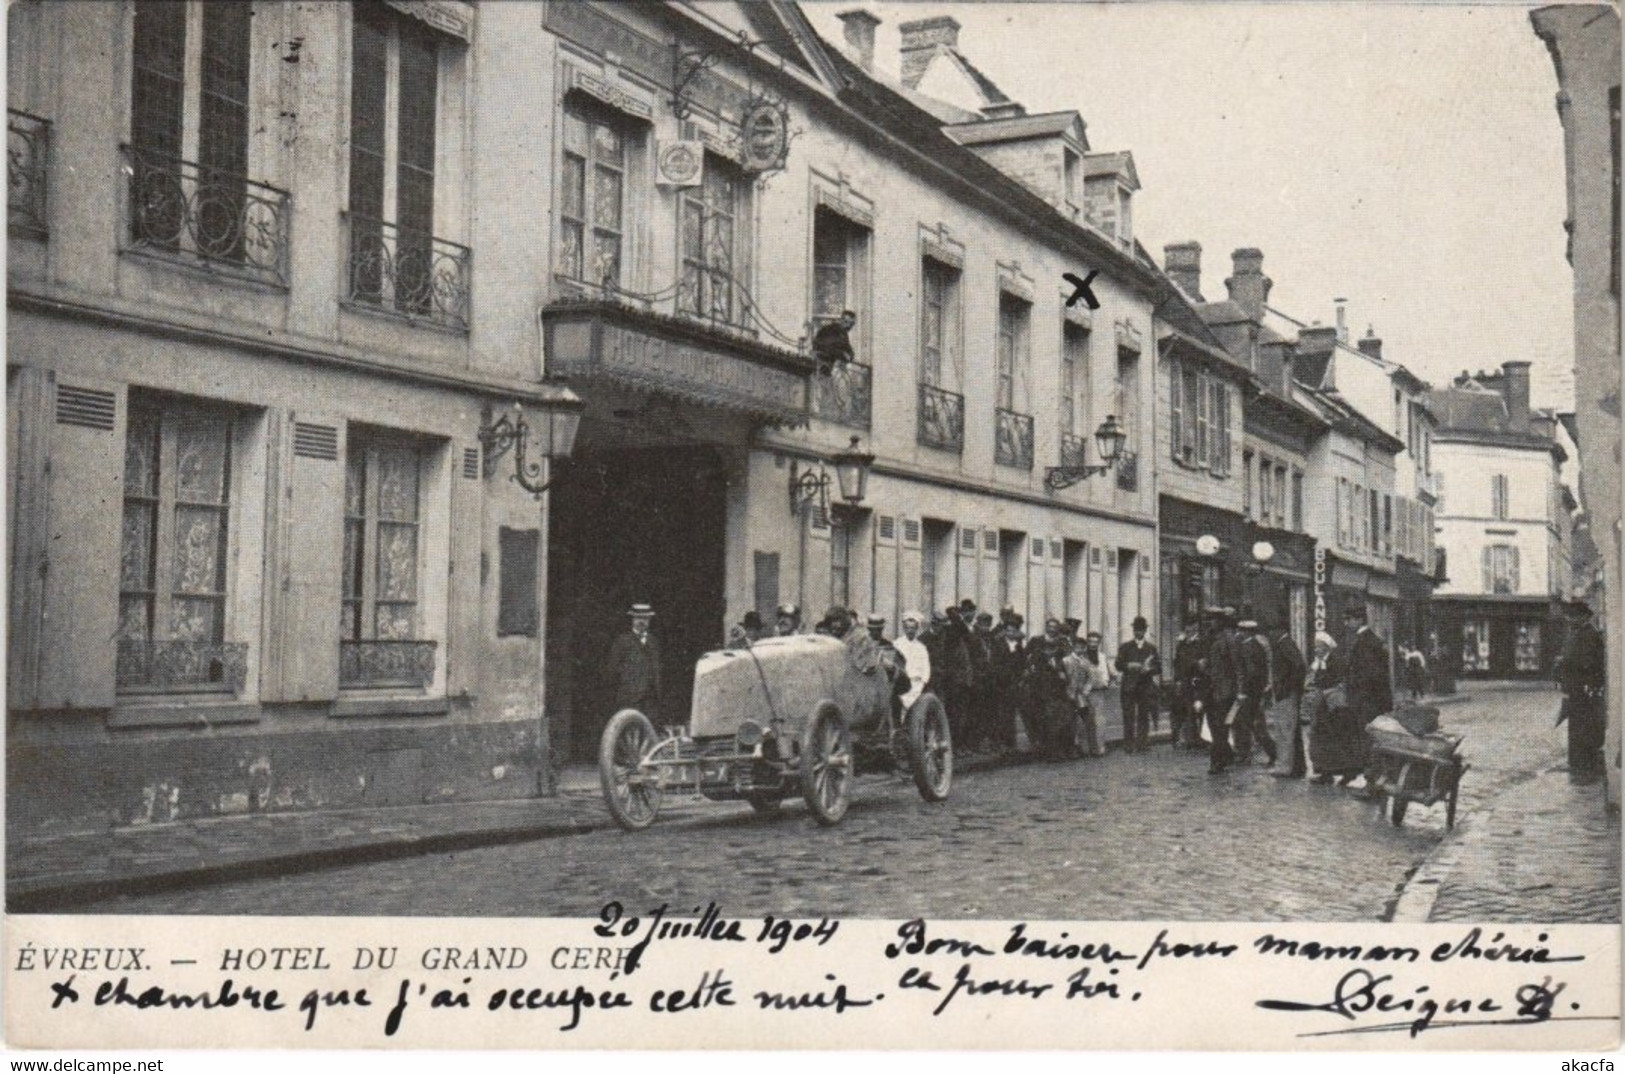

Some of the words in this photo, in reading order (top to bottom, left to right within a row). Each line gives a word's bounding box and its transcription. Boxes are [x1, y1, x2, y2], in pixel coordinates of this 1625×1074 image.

[594, 901, 640, 937] 20
[757, 916, 839, 954] 1904
[1136, 930, 1238, 970] pour
[1254, 934, 1420, 962] maman
[1430, 928, 1585, 963] chérie
[94, 977, 286, 1011] chambre
[299, 989, 371, 1031] que
[488, 971, 632, 1032] occupée
[649, 968, 737, 1013] cette
[933, 964, 1054, 1016] pour
